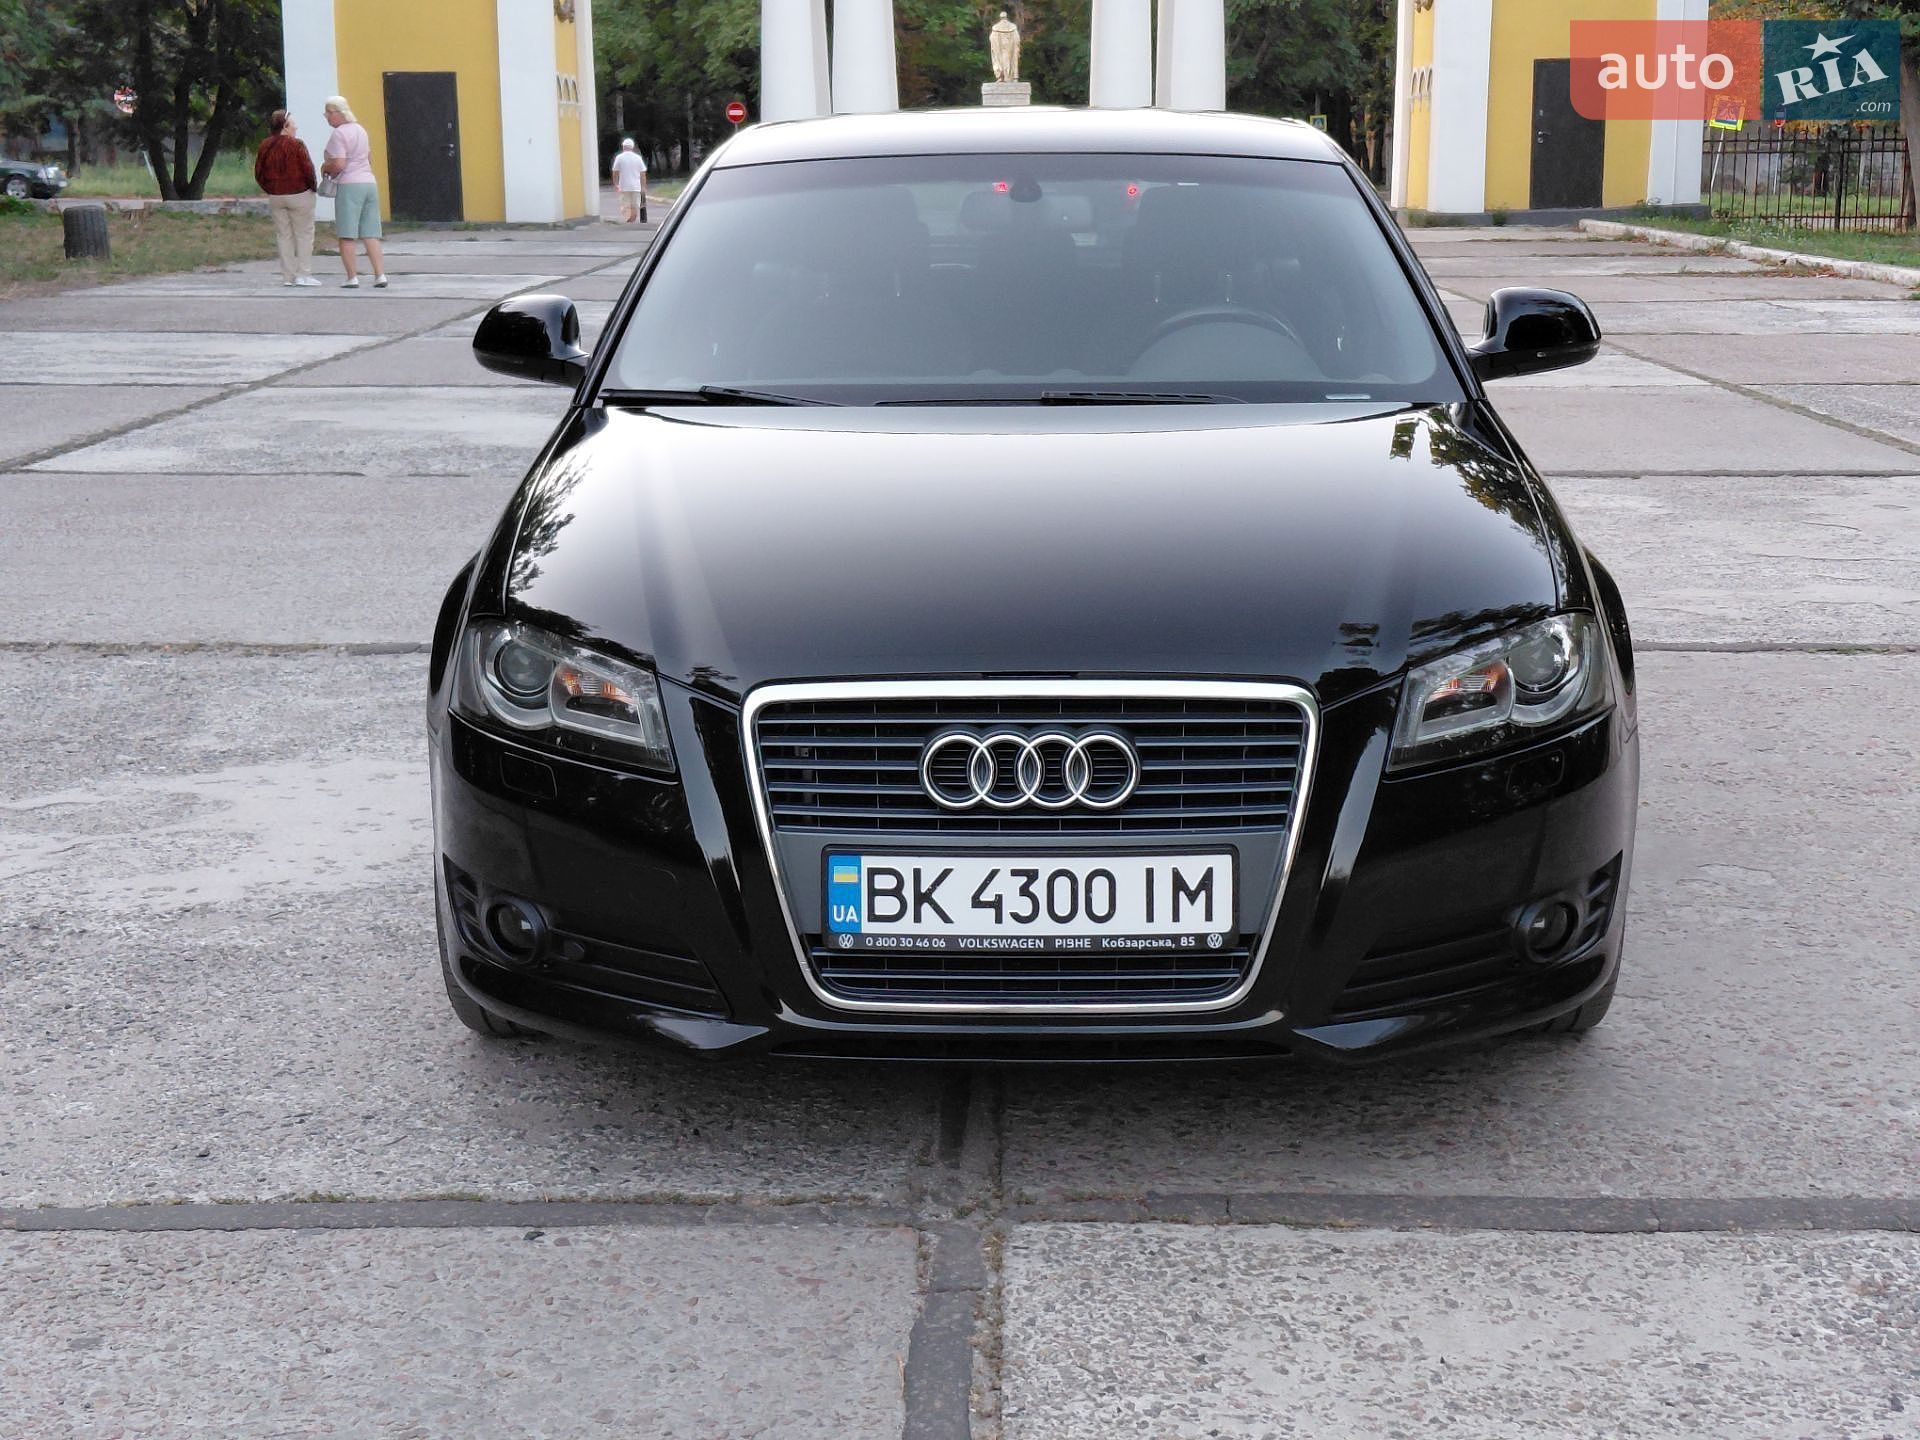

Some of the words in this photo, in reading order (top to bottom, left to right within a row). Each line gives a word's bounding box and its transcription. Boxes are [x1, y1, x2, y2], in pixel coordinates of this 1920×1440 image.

[867, 867, 954, 924] BK
[970, 868, 1117, 924] 4300
[1145, 867, 1213, 923] IM
[833, 905, 859, 923] UA
[865, 937, 873, 946] 0
[899, 937, 914, 947] 30
[916, 937, 930, 947] 46
[932, 938, 946, 948] 06
[958, 938, 1045, 949] VOLKSWAGEN
[1180, 936, 1196, 947] 85
